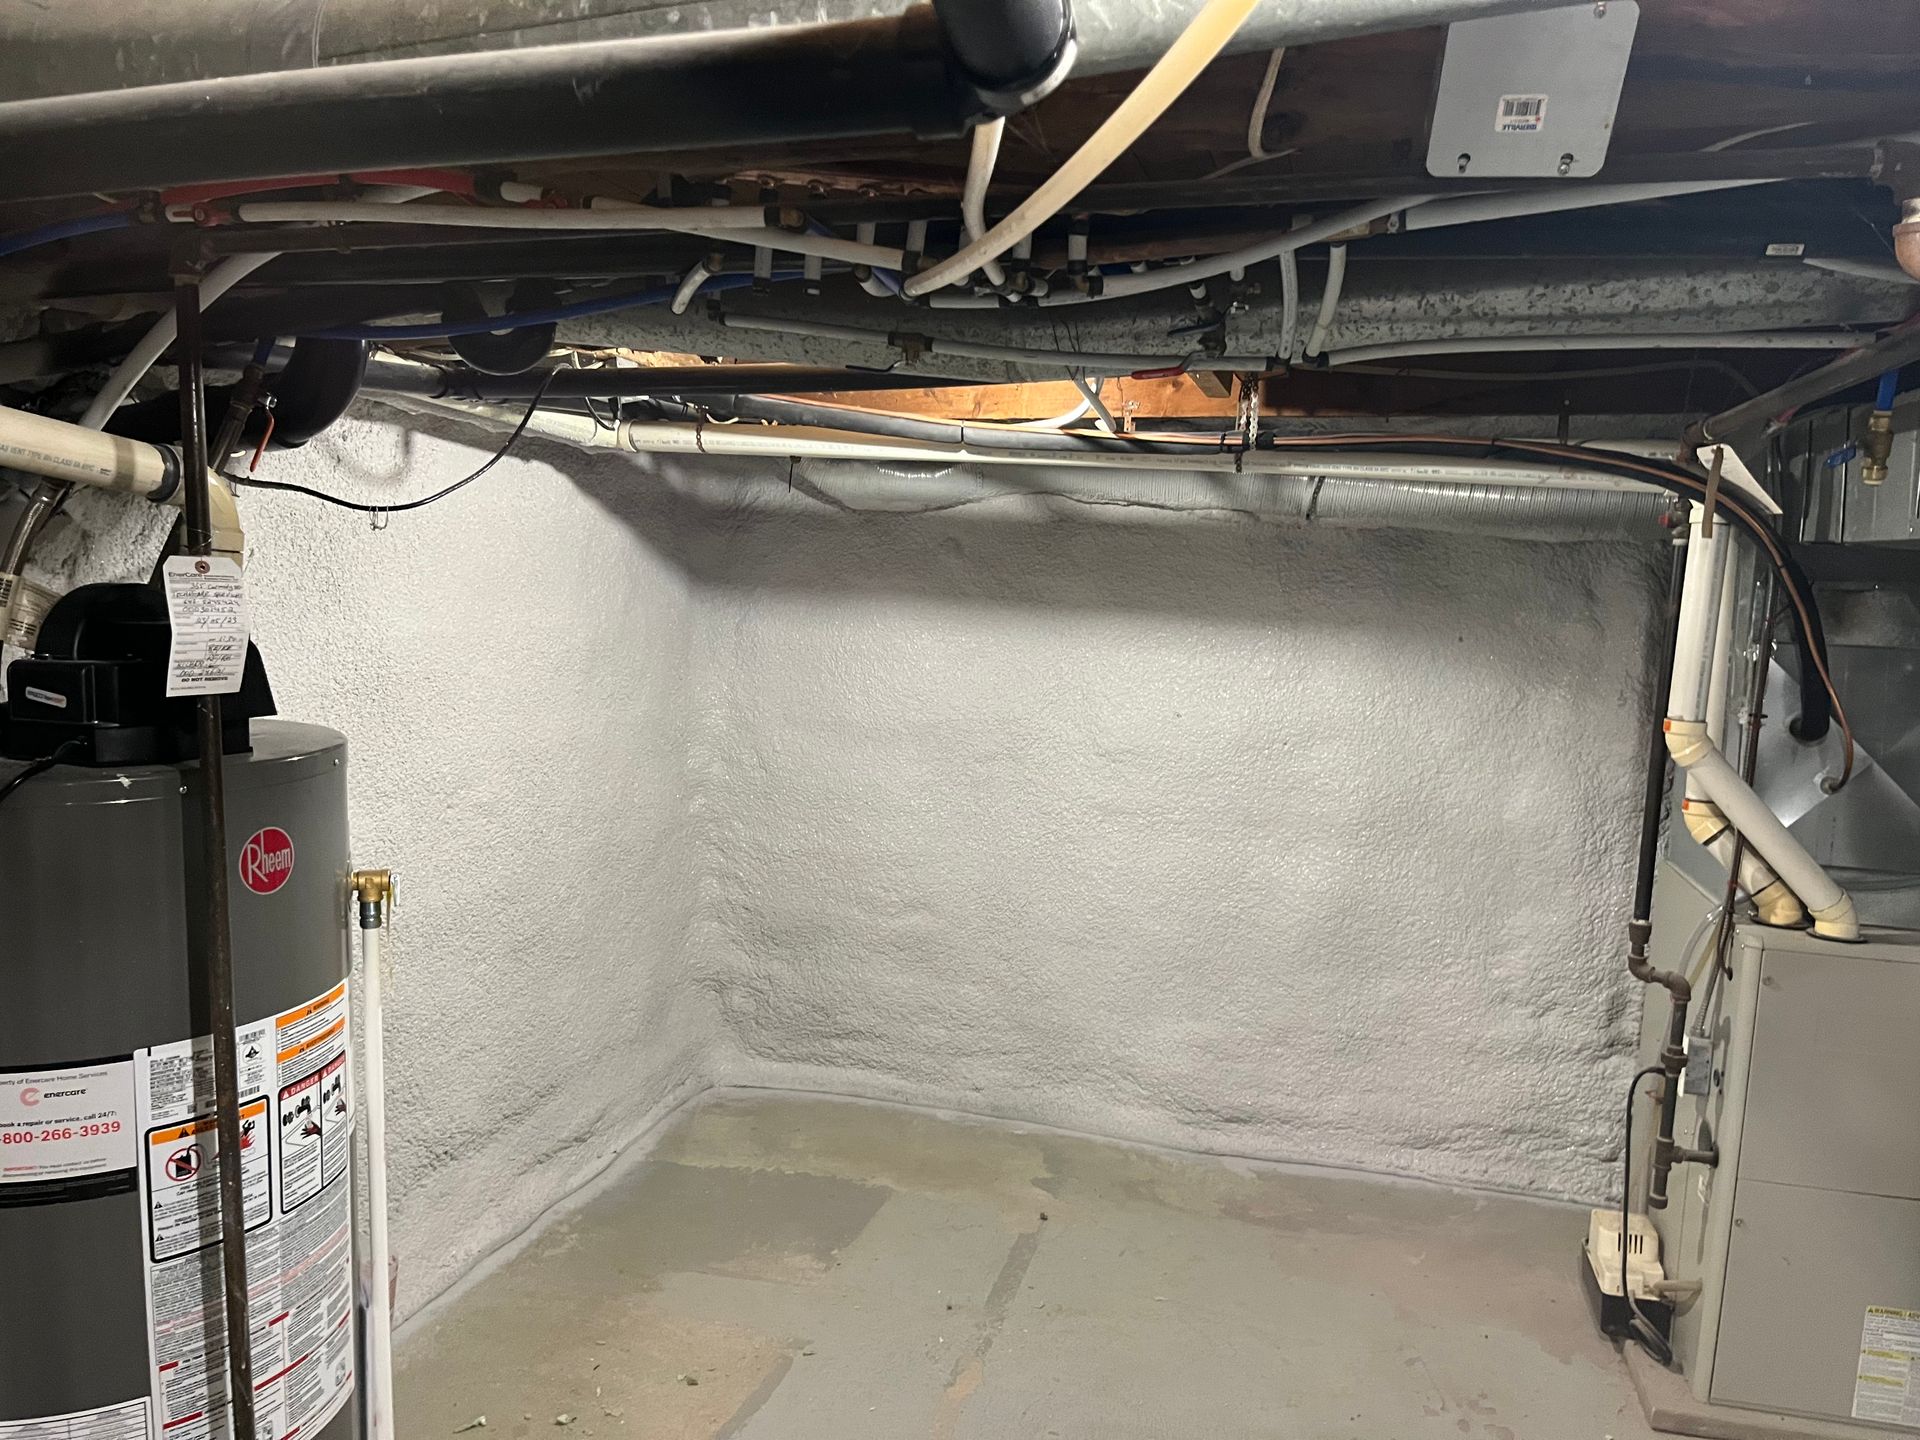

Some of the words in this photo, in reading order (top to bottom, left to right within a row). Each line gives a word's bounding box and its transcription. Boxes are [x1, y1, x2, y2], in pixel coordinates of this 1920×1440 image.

[247, 830, 292, 885] Rheem
[25, 1076, 55, 1085] Enercare
[57, 1074, 77, 1082] Home
[78, 1071, 107, 1079] Services
[290, 1073, 320, 1095] DANGER
[44, 1088, 86, 1099] enercare
[22, 1119, 43, 1127] repair
[0, 1121, 121, 1144] 800-266-3939
